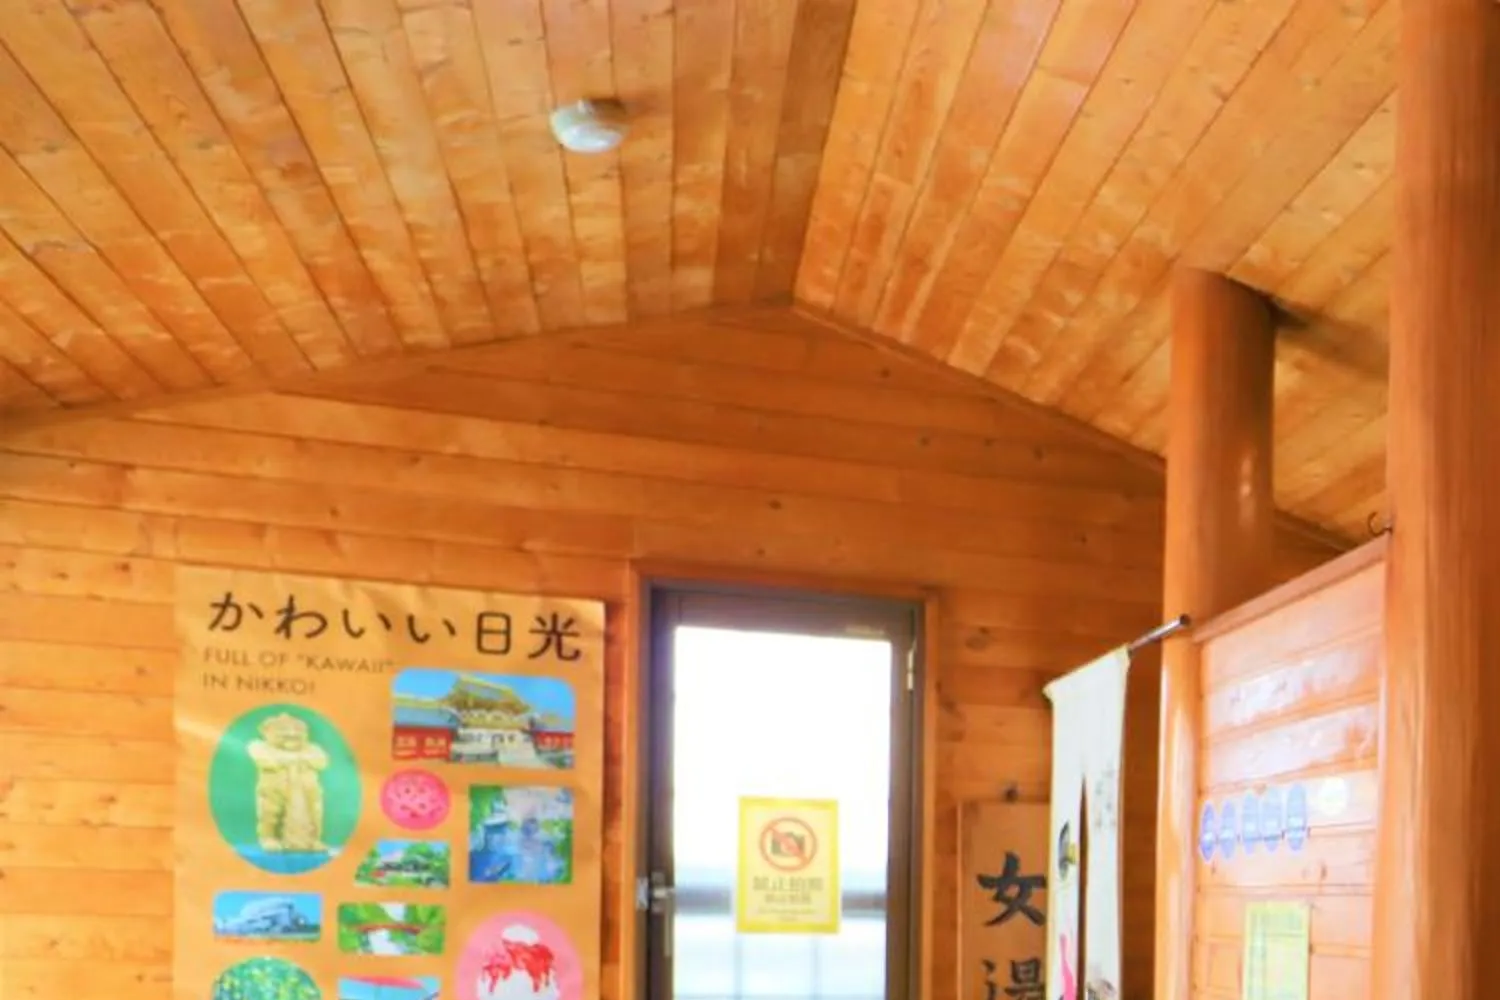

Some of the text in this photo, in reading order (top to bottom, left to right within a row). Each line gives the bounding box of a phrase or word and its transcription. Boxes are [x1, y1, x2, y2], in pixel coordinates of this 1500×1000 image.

[207, 590, 582, 662] かわいい日光
[203, 647, 250, 667] FULL
[258, 650, 290, 667] OF
[203, 672, 229, 691] IN
